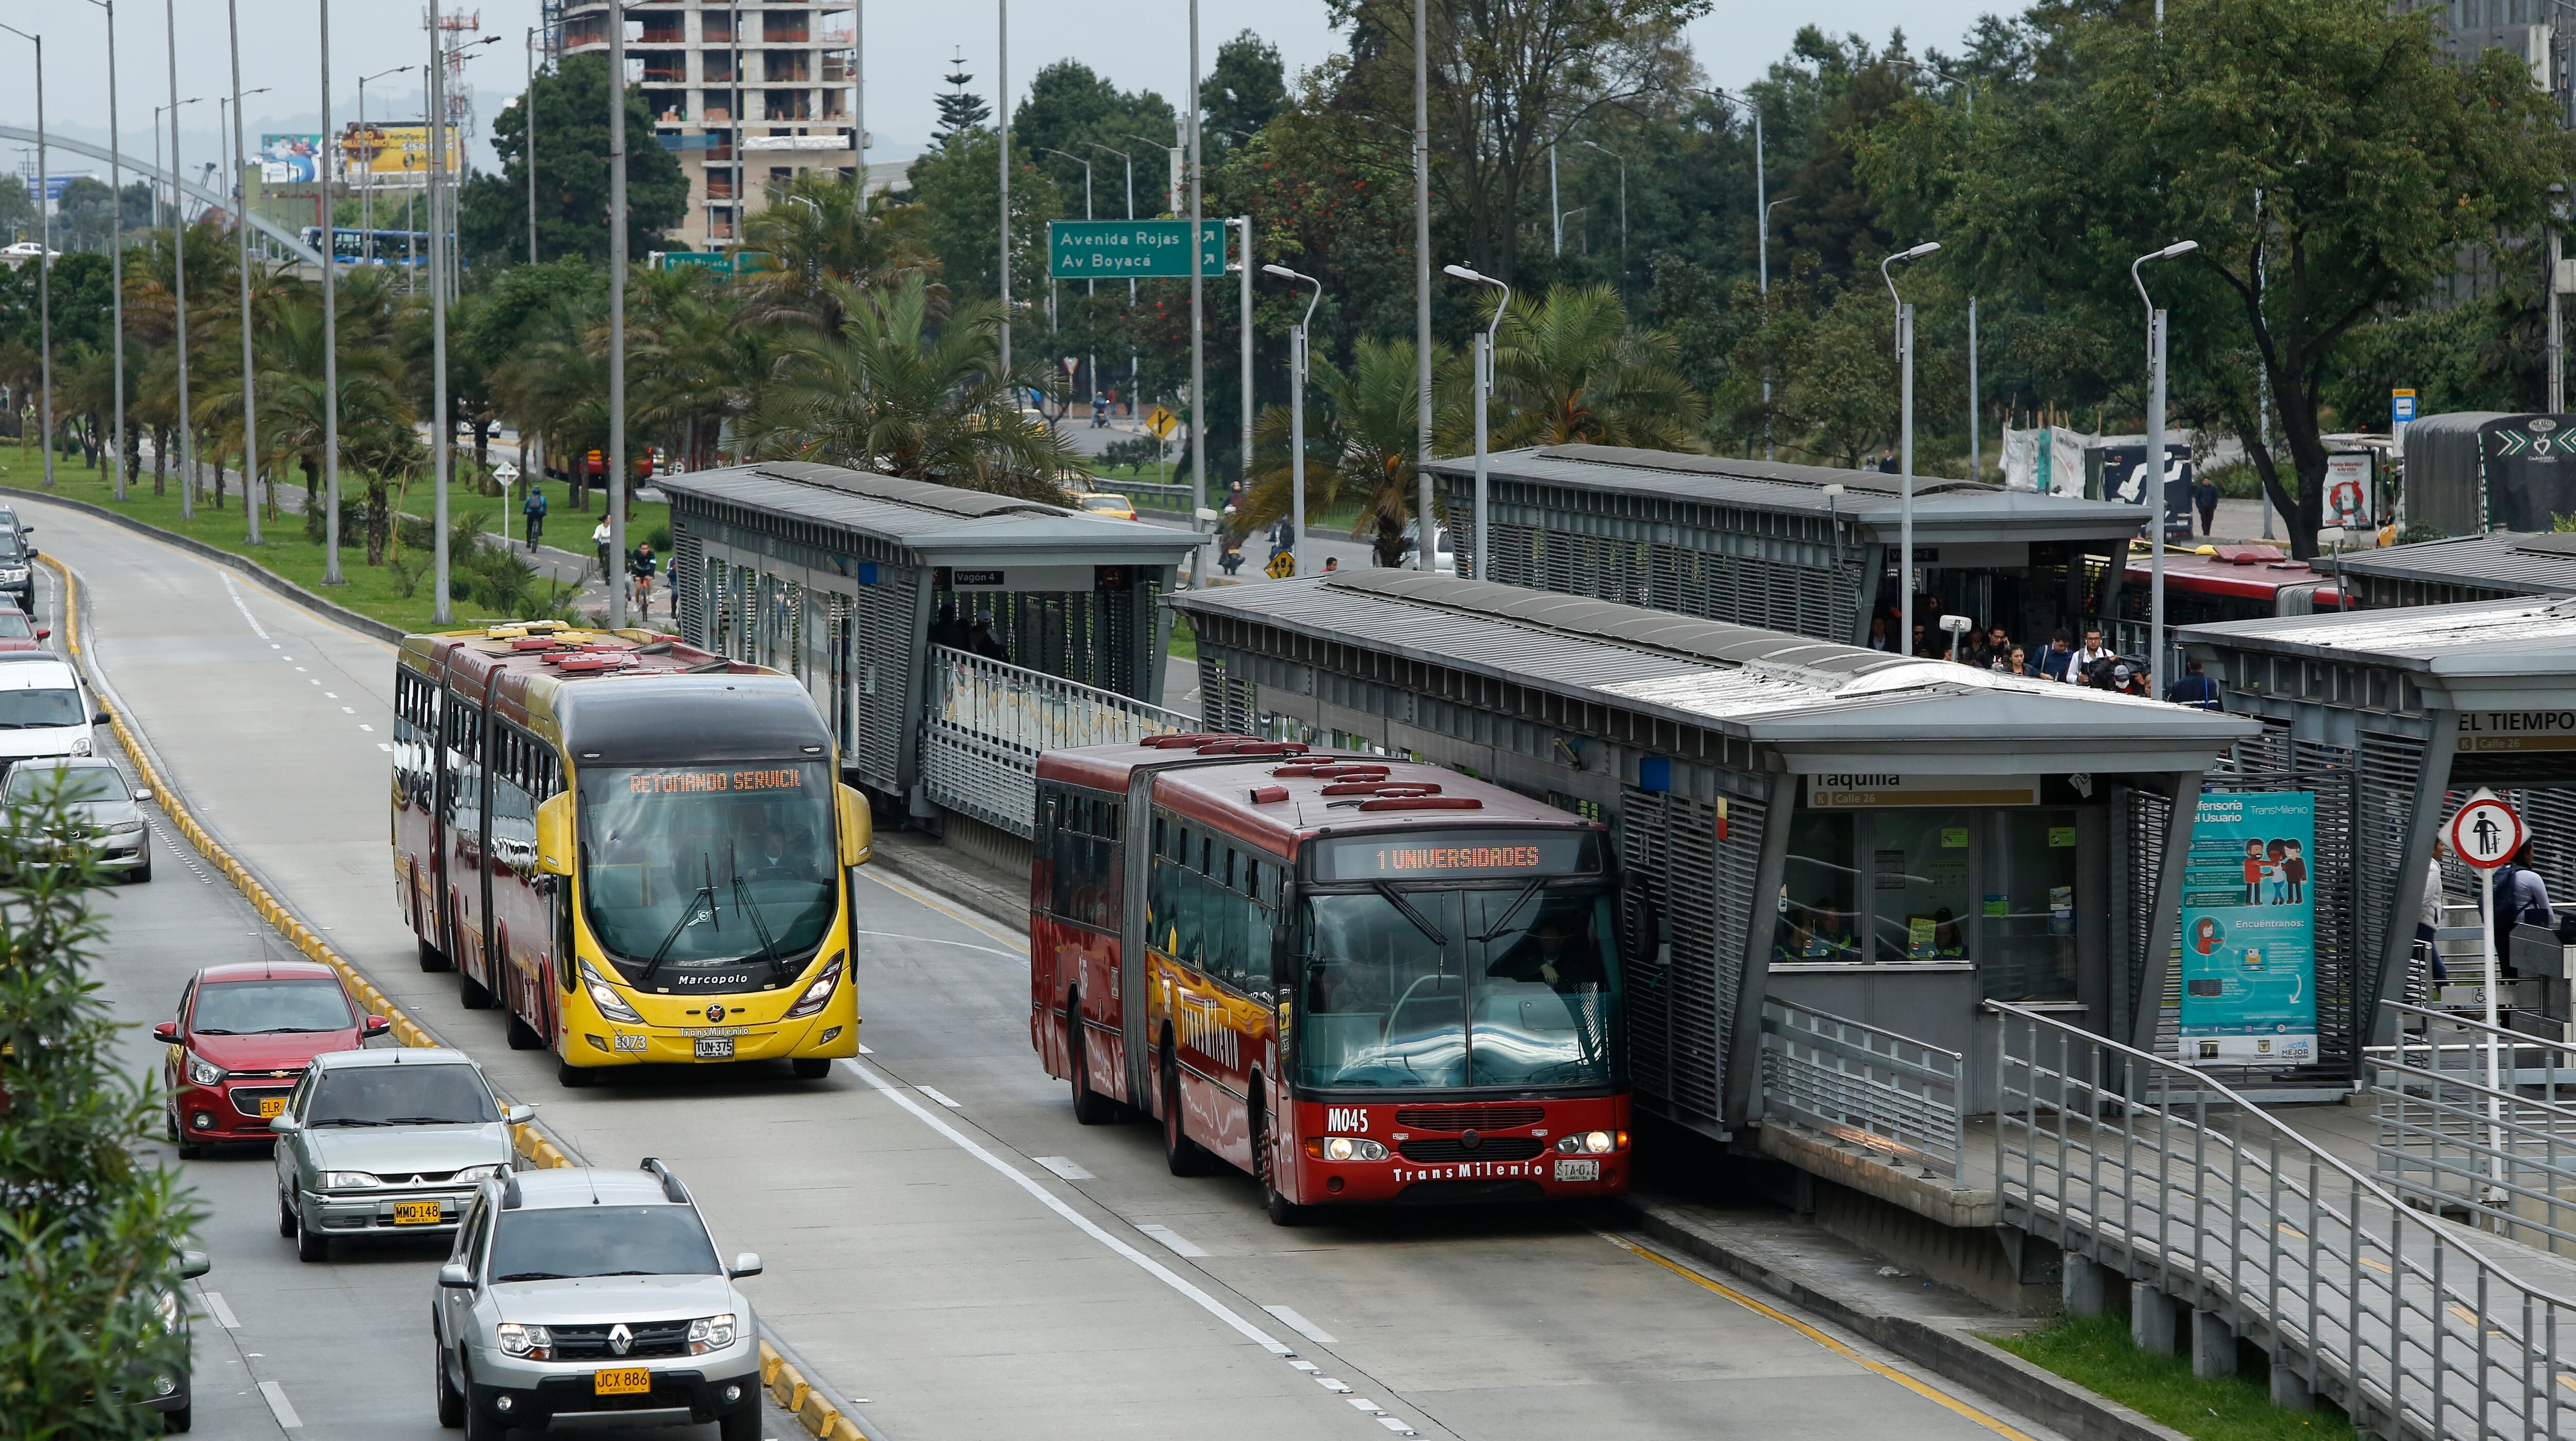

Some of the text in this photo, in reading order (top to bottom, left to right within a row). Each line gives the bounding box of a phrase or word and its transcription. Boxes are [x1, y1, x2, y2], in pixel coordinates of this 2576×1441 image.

[1060, 231, 1179, 248] Avenida Rojas
[1062, 253, 1151, 270] Av Boyacá
[957, 572, 995, 583] Vagón 4
[2458, 711, 2575, 731] EL TIEMPO
[2462, 739, 2520, 749] K Calle 26
[630, 772, 727, 793] RETOMANDO
[1818, 793, 1875, 804] K Calle 26
[2196, 799, 2243, 811] fensoría
[2250, 805, 2308, 815] TransMilenio
[2202, 812, 2242, 823] Usuario
[1377, 846, 1539, 870] 1 UNIVERSIDADES
[2236, 920, 2304, 928] Encuéntranos:
[678, 974, 748, 985] Marcopolo
[679, 1026, 750, 1038] TransMilenio
[1180, 990, 1239, 1072] TransMilenio
[614, 1035, 648, 1049] E073
[696, 1041, 733, 1053] TUN-375
[1328, 1108, 1368, 1132] M045
[1393, 1162, 1543, 1182] TransMilenio
